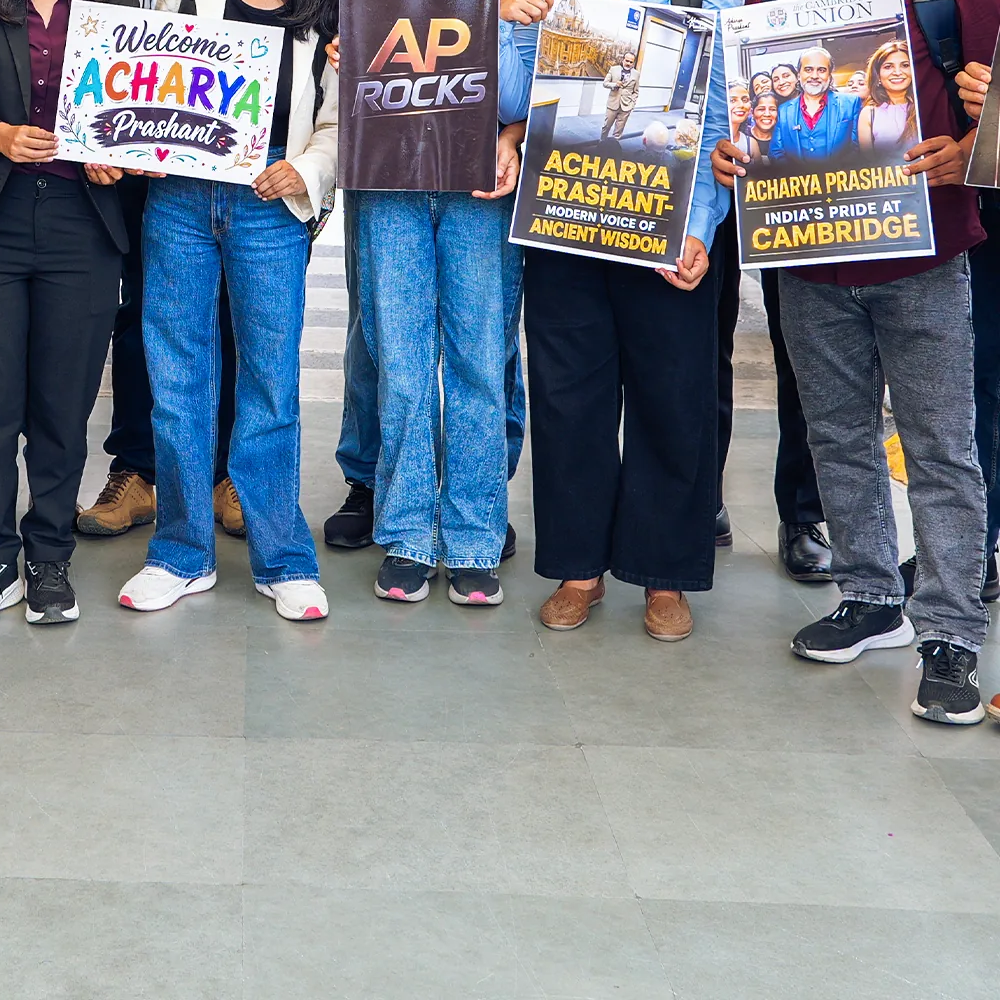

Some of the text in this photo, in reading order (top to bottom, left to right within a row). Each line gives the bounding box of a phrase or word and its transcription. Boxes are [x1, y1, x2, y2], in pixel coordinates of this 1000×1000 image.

[794, 1, 873, 28] UNION
[112, 20, 233, 61] Welcome
[366, 18, 471, 73] AP
[73, 57, 262, 126] ACHARYA
[351, 72, 488, 117] ROCKS
[112, 110, 221, 146] Prashant
[544, 149, 671, 189] ACHARYA
[744, 173, 822, 203] ACHARYA
[536, 175, 674, 216] PRASHANT-
[765, 200, 901, 225] INDIA'S PRIDE AT
[529, 217, 668, 255] ANCIENT WISDOM
[545, 204, 657, 232] MODERN VOICE OF
[752, 213, 921, 250] CAMBRIDGE
